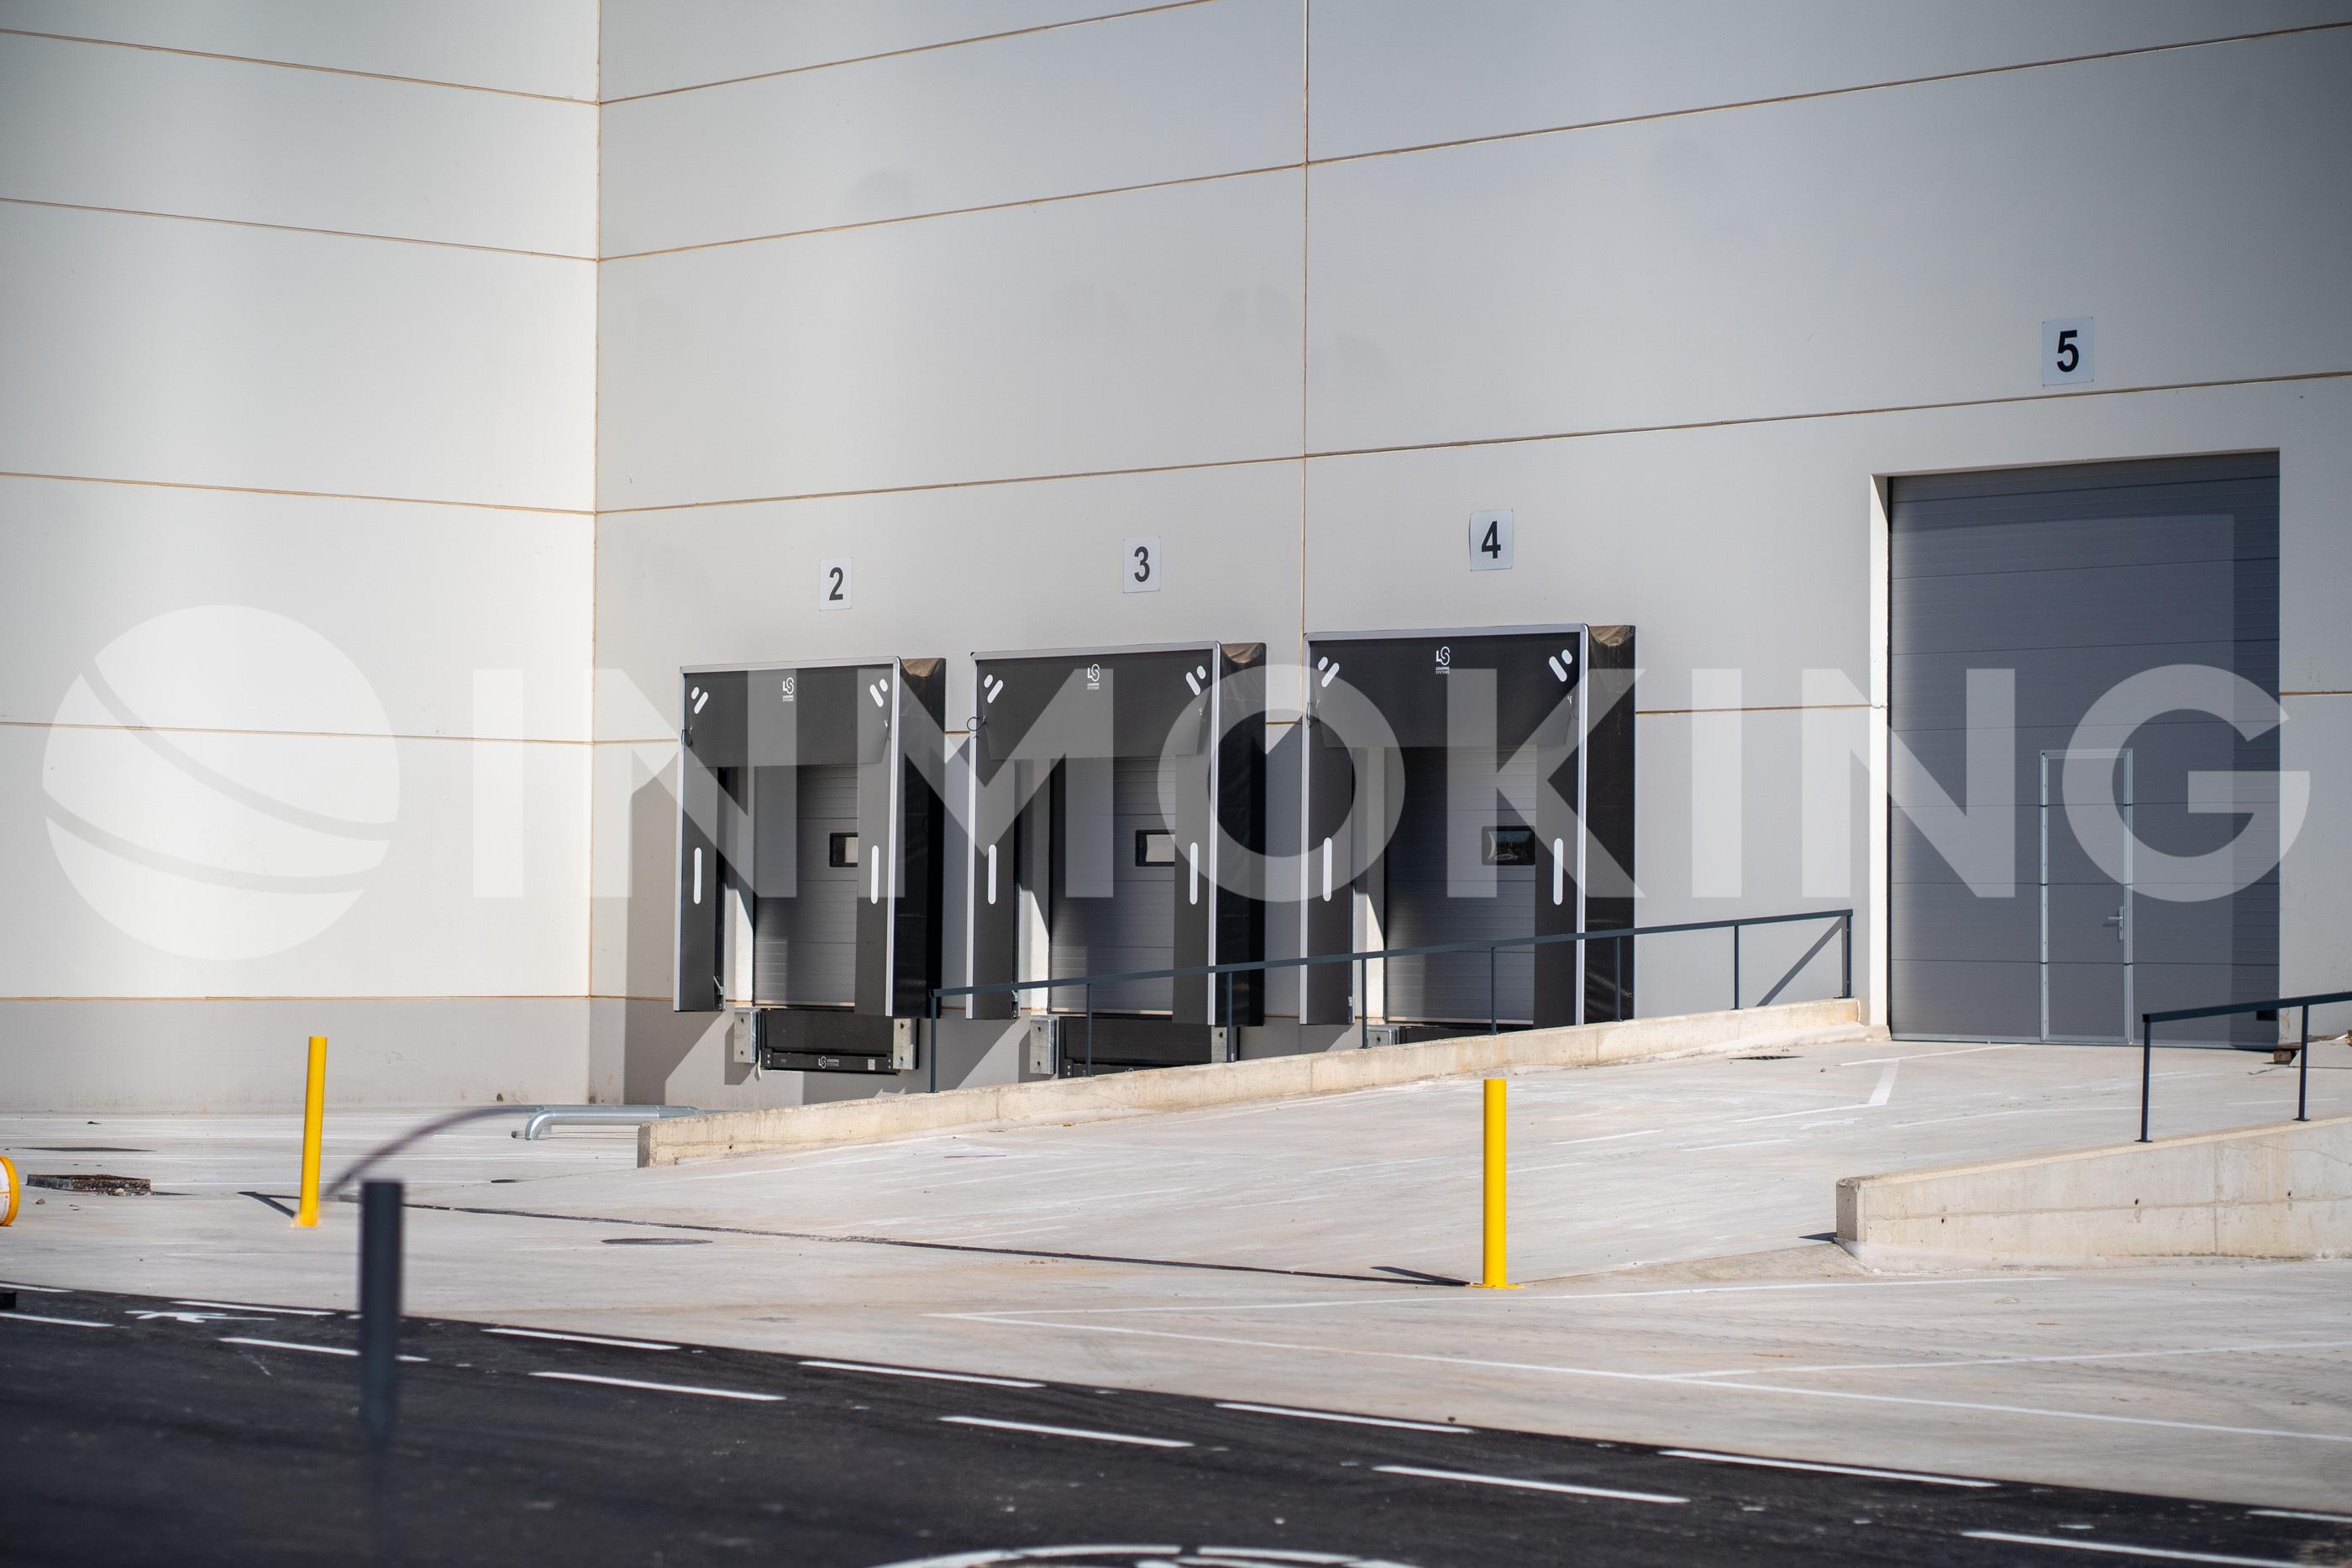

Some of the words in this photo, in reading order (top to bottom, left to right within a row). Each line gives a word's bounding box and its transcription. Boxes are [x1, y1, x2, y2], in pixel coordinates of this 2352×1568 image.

[2056, 329, 2079, 373] 5
[1481, 520, 1501, 559] 4
[1134, 546, 1150, 582] 3
[829, 567, 843, 601] 2
[1436, 646, 1450, 665] LS
